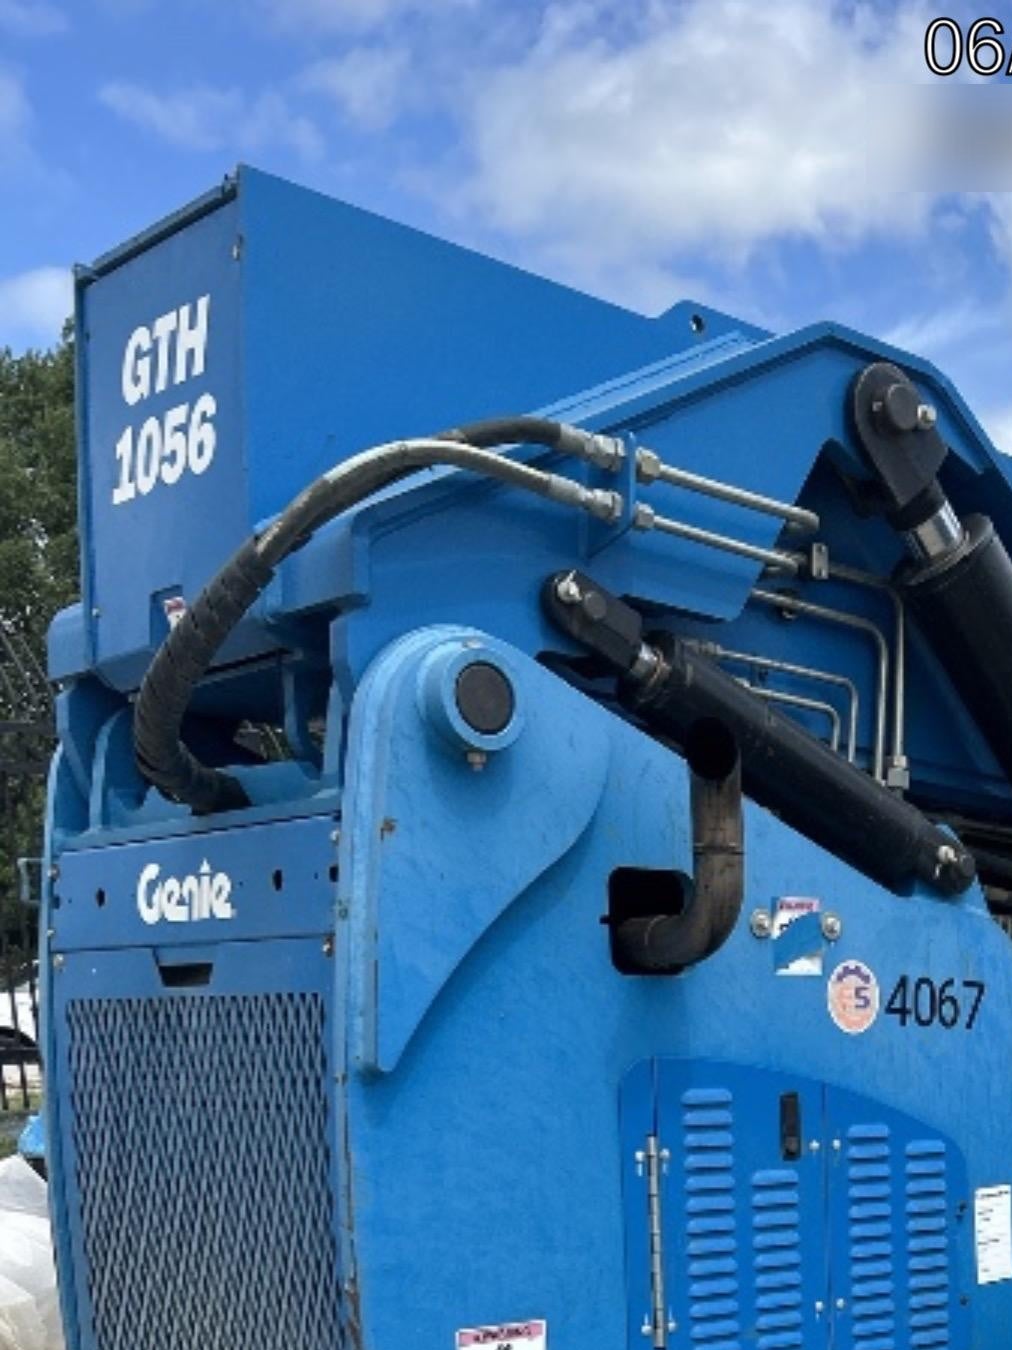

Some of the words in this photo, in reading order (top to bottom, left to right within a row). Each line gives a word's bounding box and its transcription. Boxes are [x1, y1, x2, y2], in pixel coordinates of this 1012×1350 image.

[121, 294, 211, 406] GTH
[112, 392, 217, 506] 1056
[137, 859, 233, 926] Genie
[884, 974, 986, 1030] 4067
